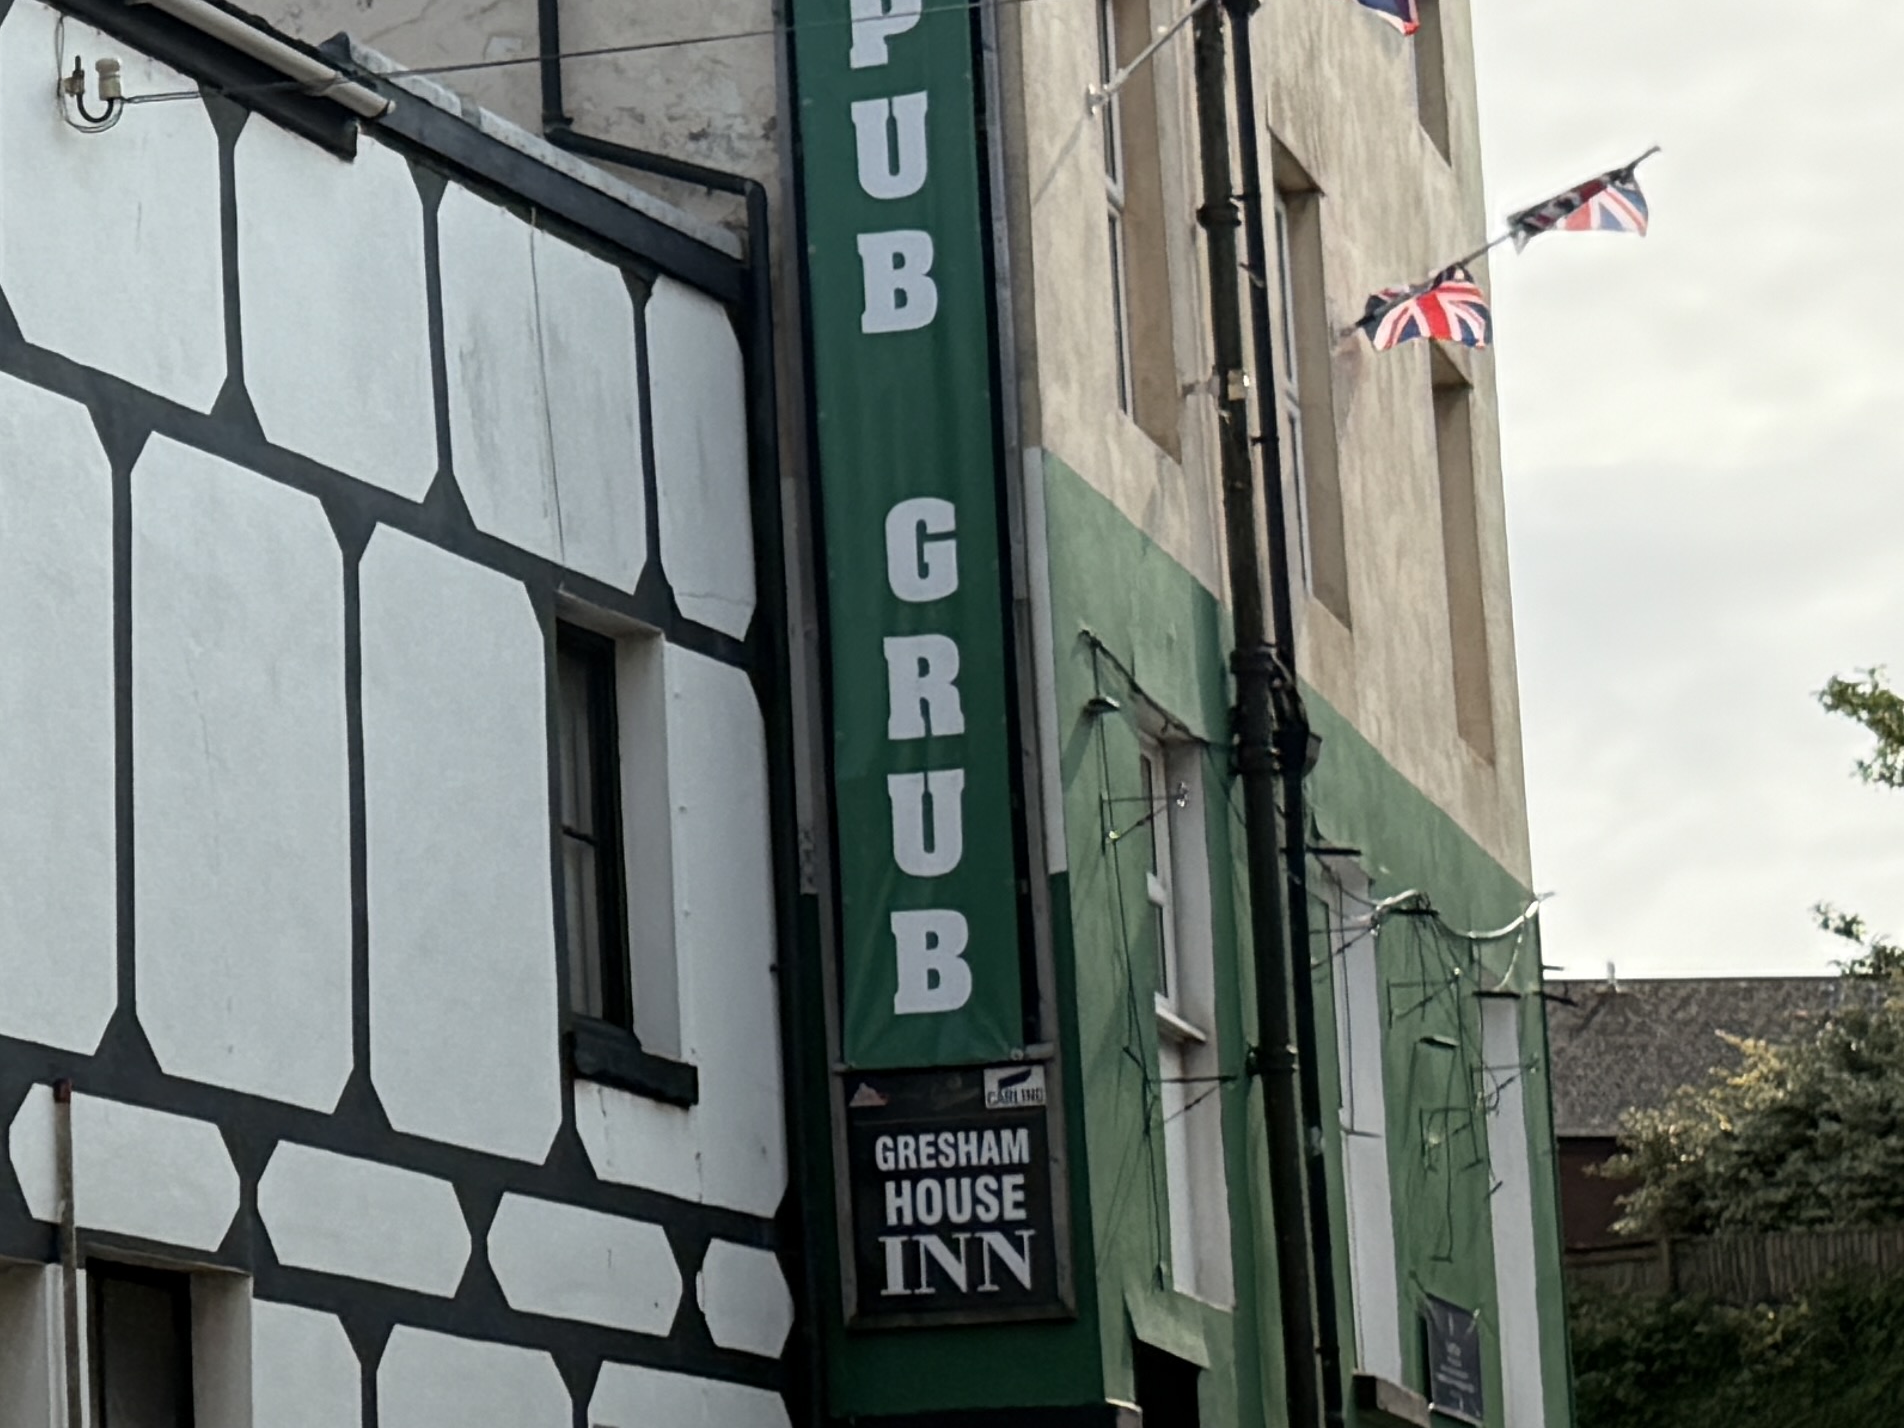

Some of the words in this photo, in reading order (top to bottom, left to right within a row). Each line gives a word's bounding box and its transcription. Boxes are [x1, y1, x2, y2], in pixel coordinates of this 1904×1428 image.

[883, 497, 974, 1018] GRUB
[875, 1128, 1030, 1172] GRESHAM
[884, 1173, 1027, 1227] HOUSE
[877, 1229, 1036, 1296] INN
